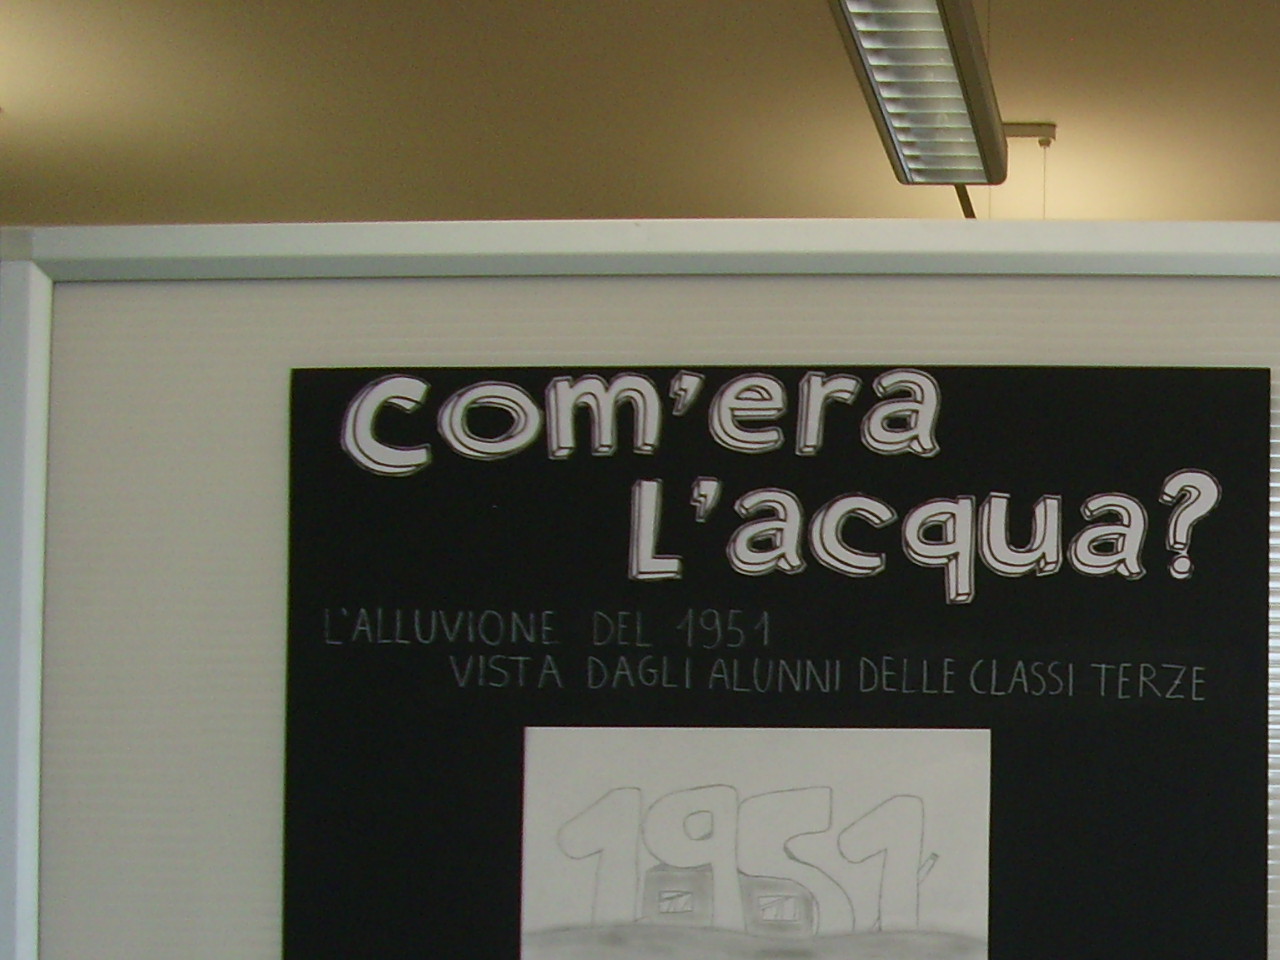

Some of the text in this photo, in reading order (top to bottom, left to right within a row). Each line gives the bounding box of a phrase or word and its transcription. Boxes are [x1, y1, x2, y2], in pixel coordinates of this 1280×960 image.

[341, 369, 942, 477] Com'era
[628, 469, 1222, 604] L'acqua?
[323, 607, 769, 649] L'ALLUVIONE DEL 1951
[449, 655, 1207, 701] VISTA DAGLI ALUNNI DELLE CLASSI TERZE
